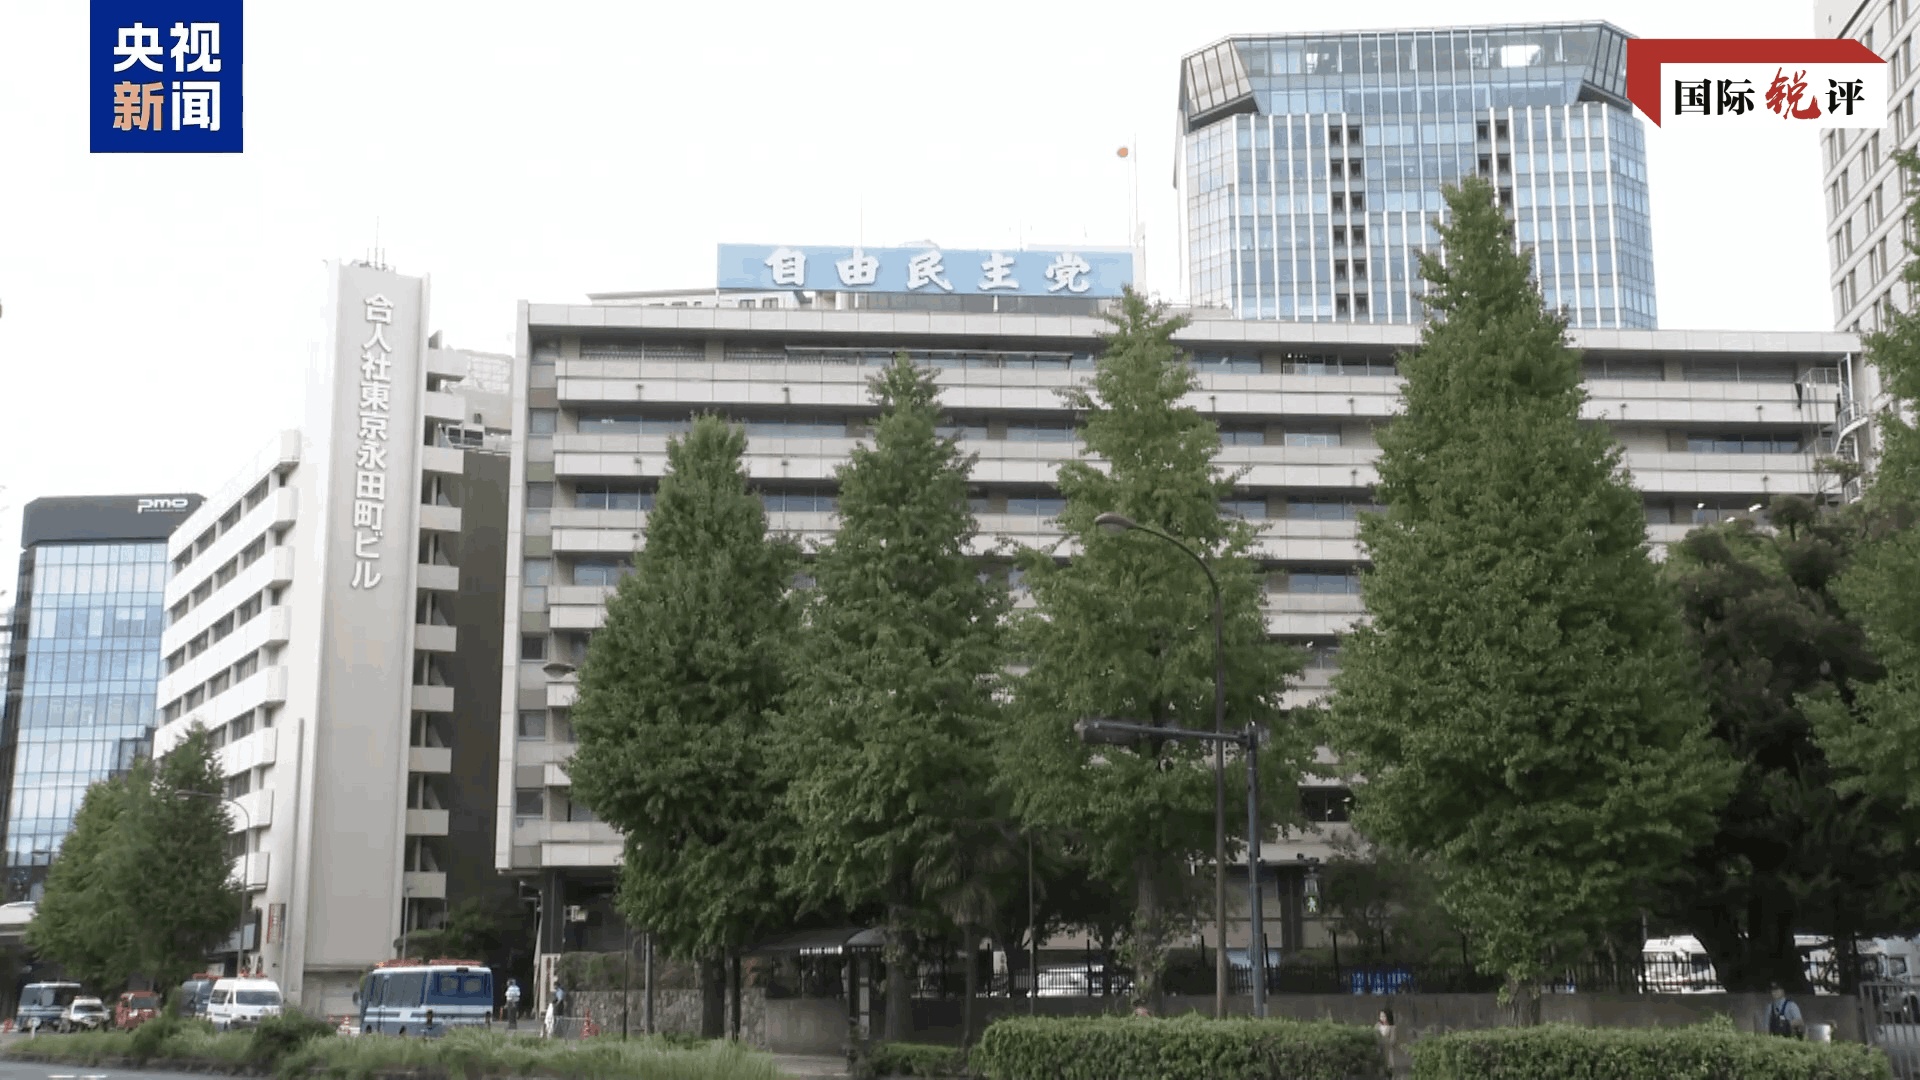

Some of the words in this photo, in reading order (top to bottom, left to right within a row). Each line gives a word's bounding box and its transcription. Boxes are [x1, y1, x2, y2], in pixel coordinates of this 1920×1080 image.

[764, 248, 1091, 293] 自由民主党
[351, 293, 393, 589] 合人社東京永田町ビル
[137, 498, 188, 514] pmo
